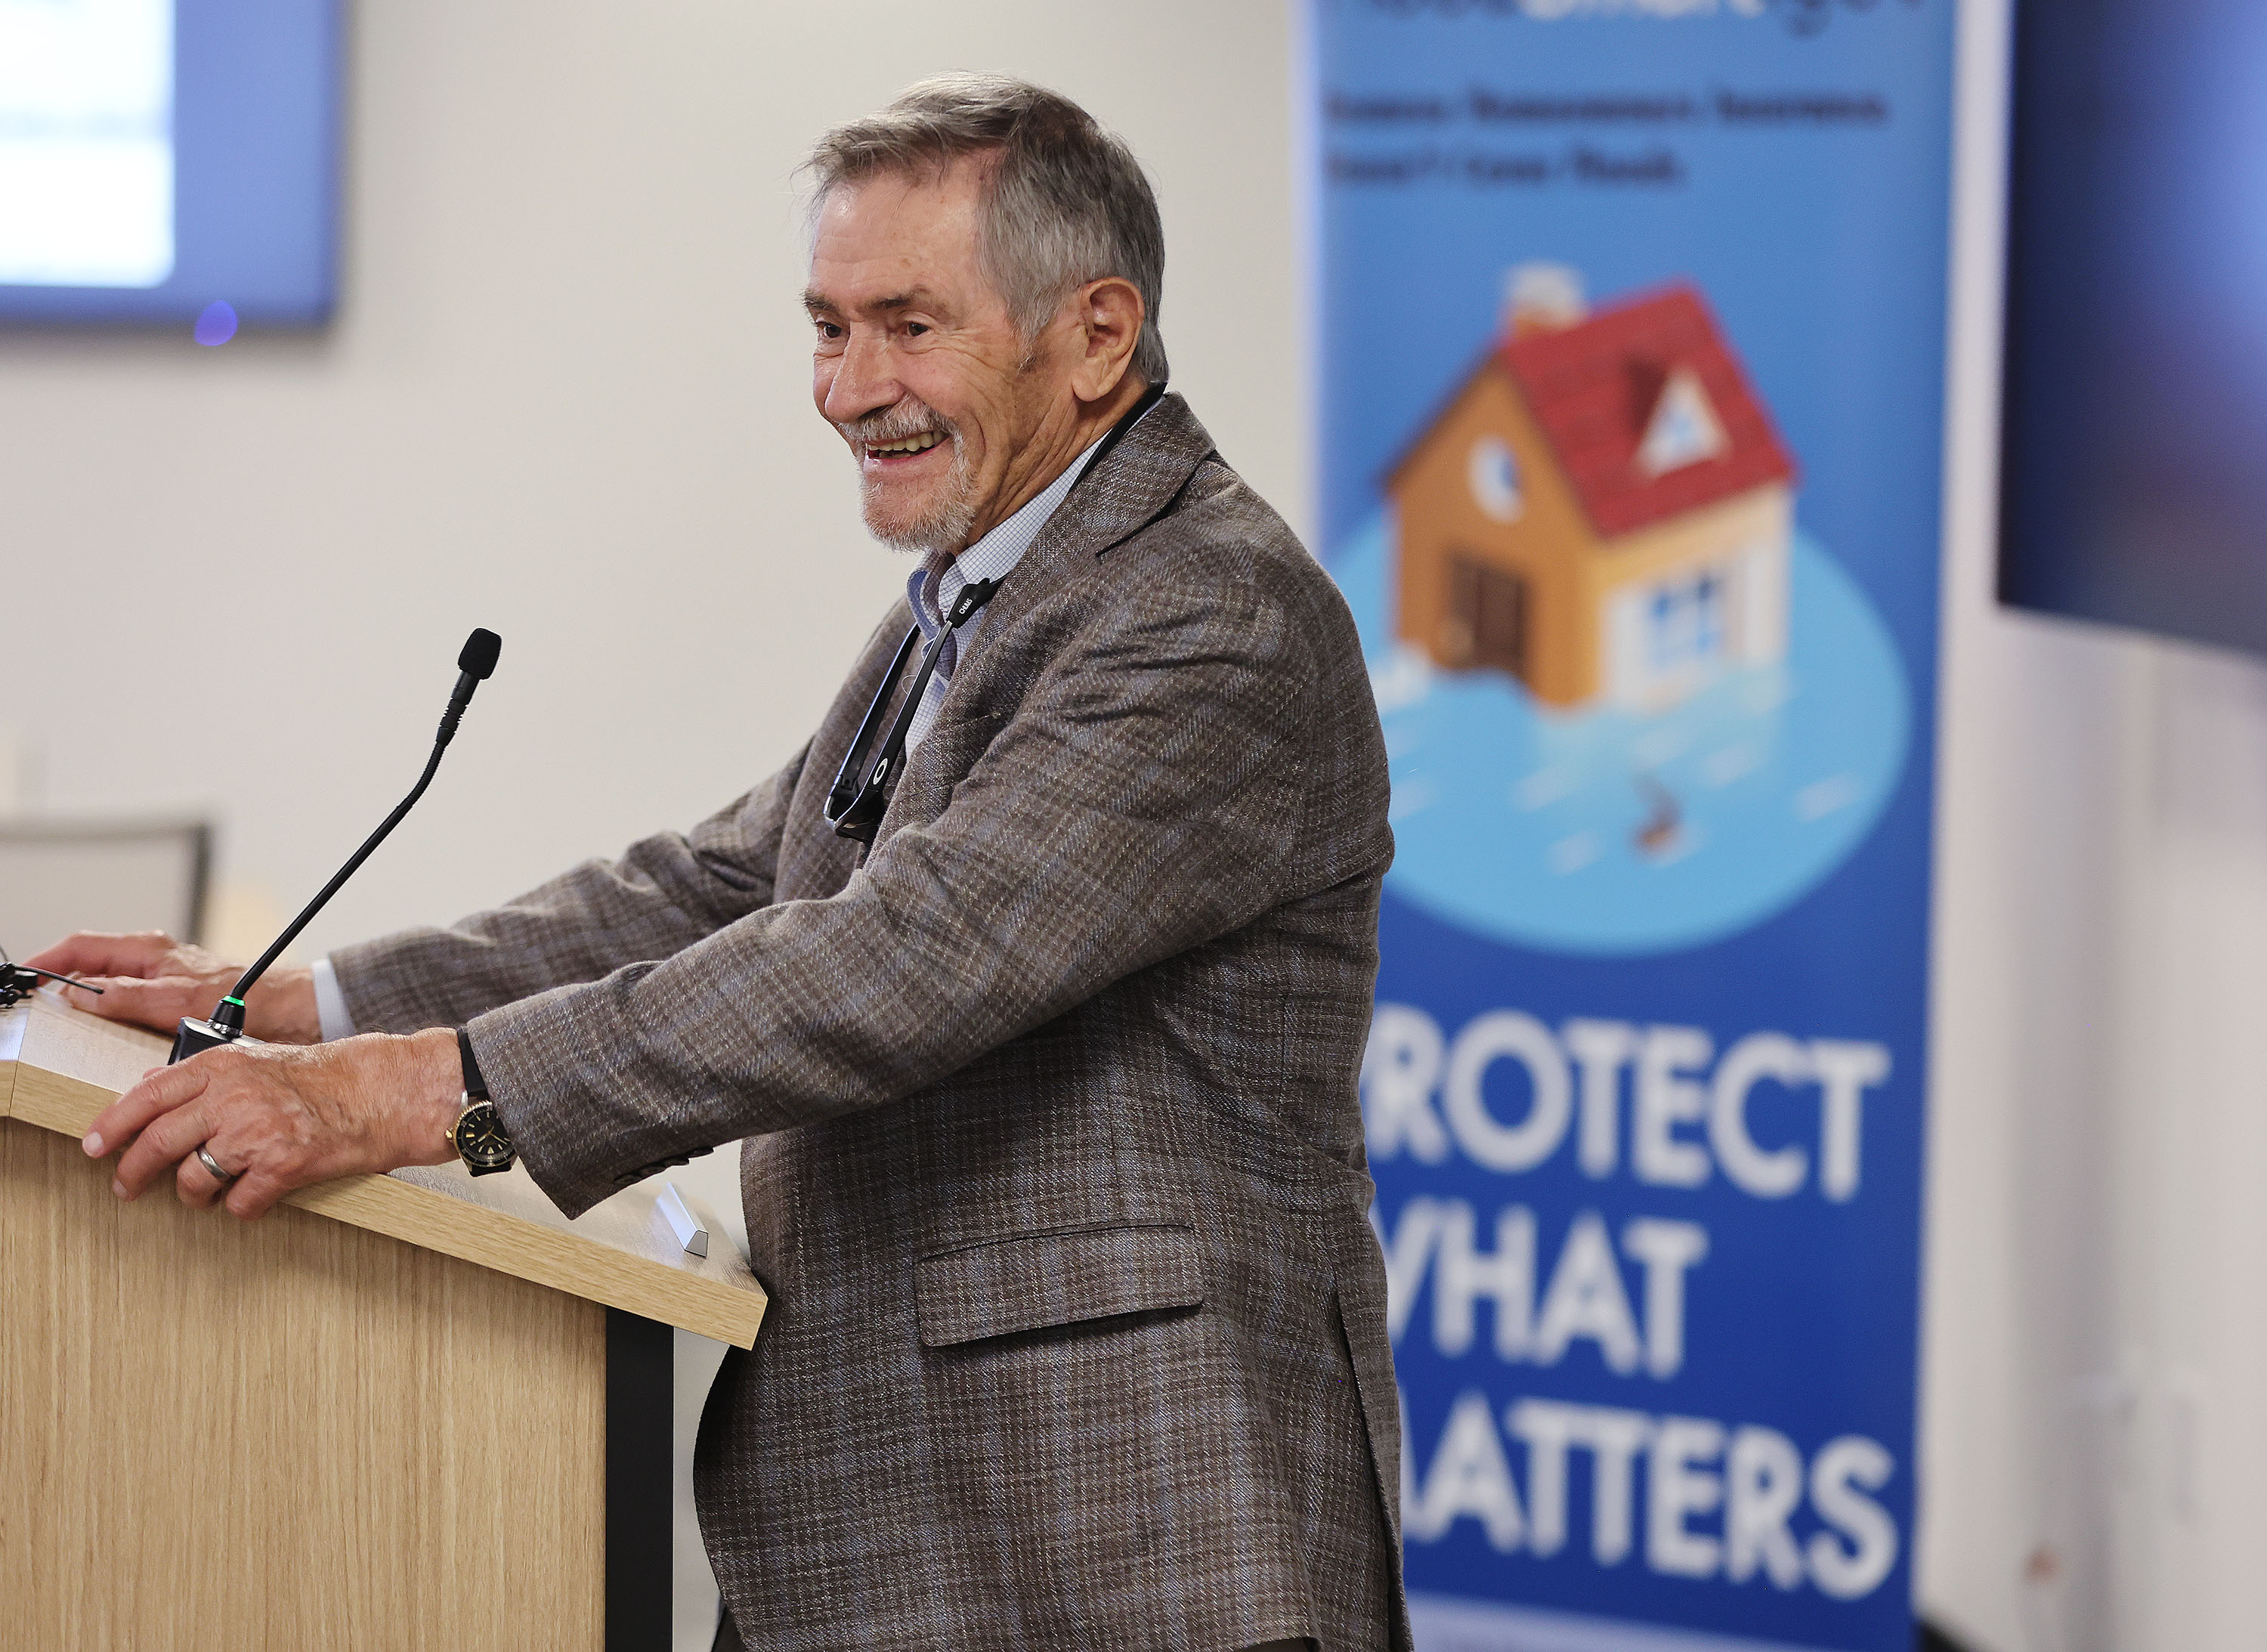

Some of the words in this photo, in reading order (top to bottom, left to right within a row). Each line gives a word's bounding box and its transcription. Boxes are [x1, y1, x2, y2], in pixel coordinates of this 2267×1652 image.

[958, 598, 973, 614] CHUMS
[1360, 1004, 1891, 1202] ROTECT
[1398, 1387, 1898, 1601] ATTERS
